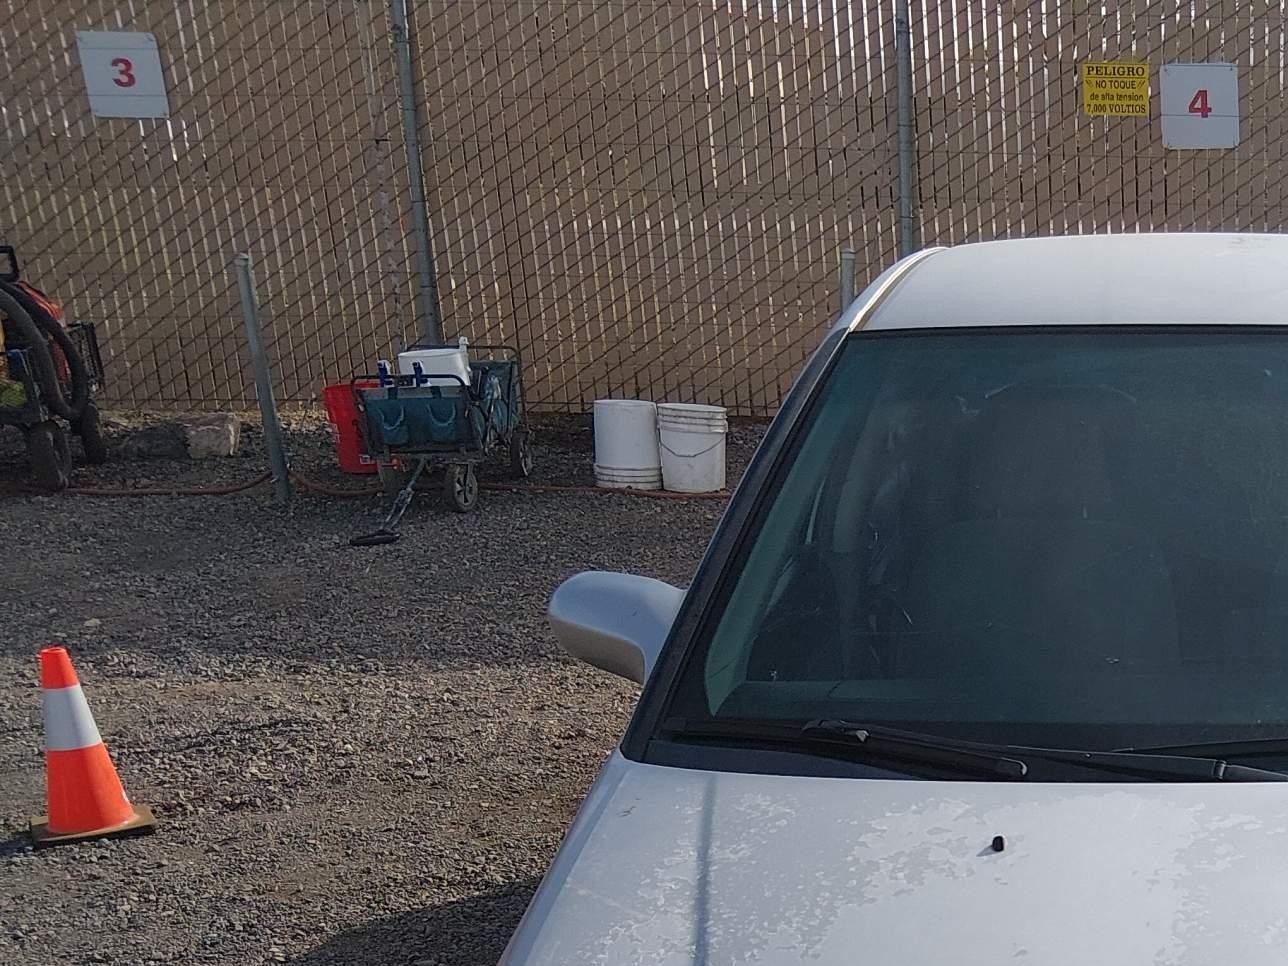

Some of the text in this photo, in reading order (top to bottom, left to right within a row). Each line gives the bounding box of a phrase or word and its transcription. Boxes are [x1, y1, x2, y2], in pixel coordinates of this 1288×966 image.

[111, 58, 136, 88] 3
[1087, 66, 1145, 76] PELIGRO
[1095, 80, 1136, 89] NO TOQUE
[1090, 92, 1099, 101] de
[1100, 92, 1114, 101] alta
[1188, 89, 1212, 118] 4
[1086, 104, 1146, 114] 7,000 VOLTIOS
